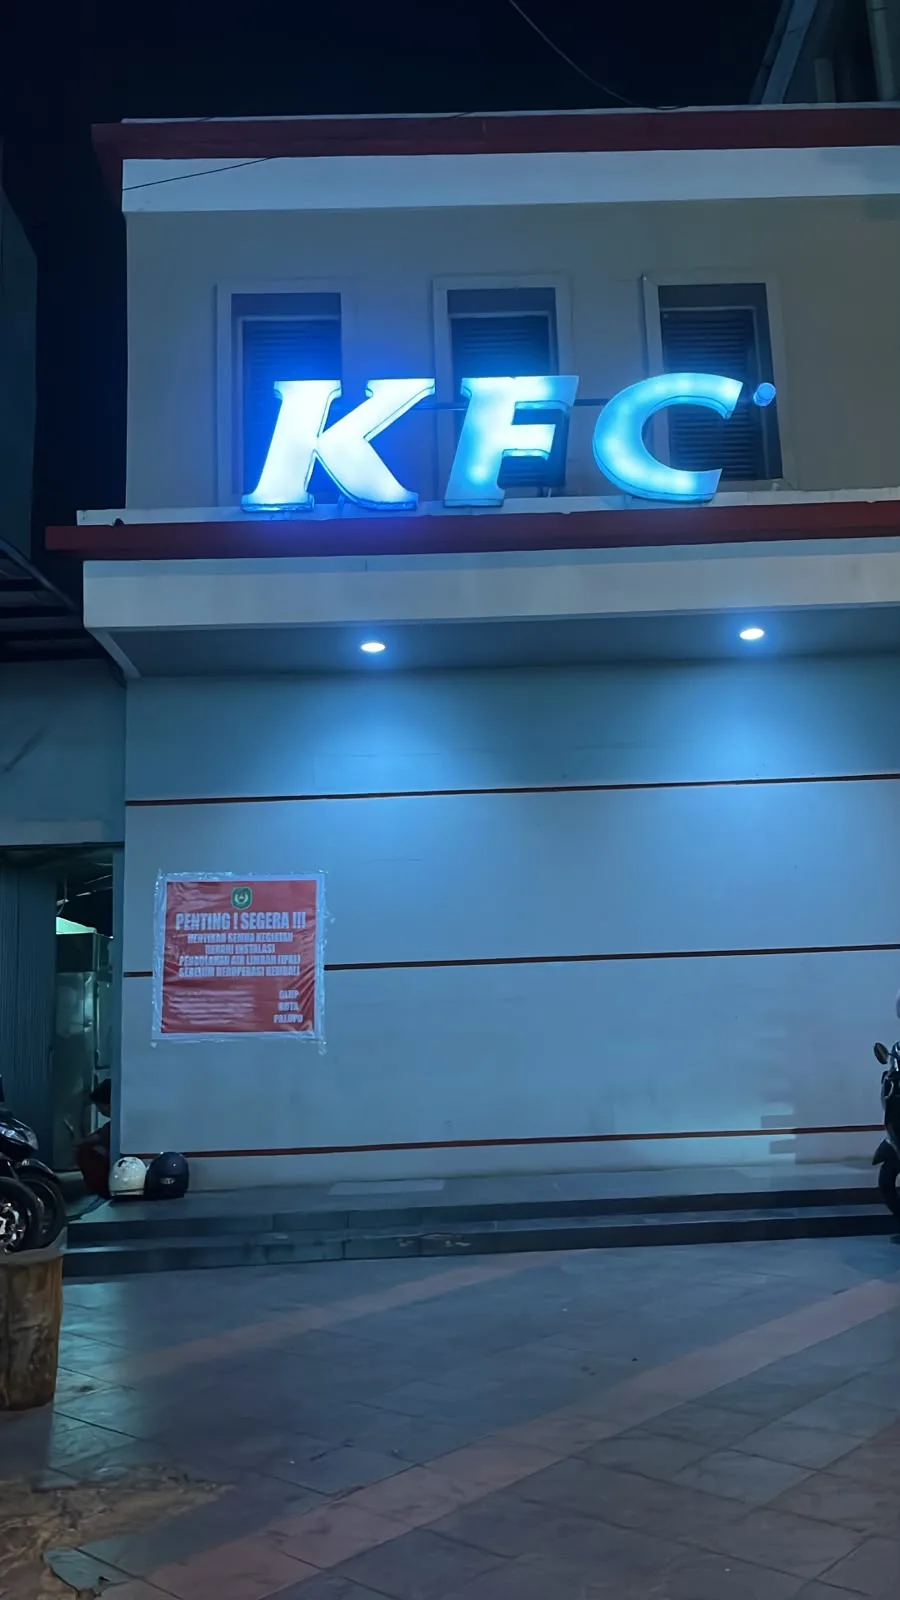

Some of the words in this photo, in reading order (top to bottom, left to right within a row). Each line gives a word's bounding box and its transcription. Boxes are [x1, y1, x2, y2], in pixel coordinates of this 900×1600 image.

[242, 373, 743, 510] KFC
[175, 913, 231, 931] PENTING
[240, 912, 290, 930] SEGERA
